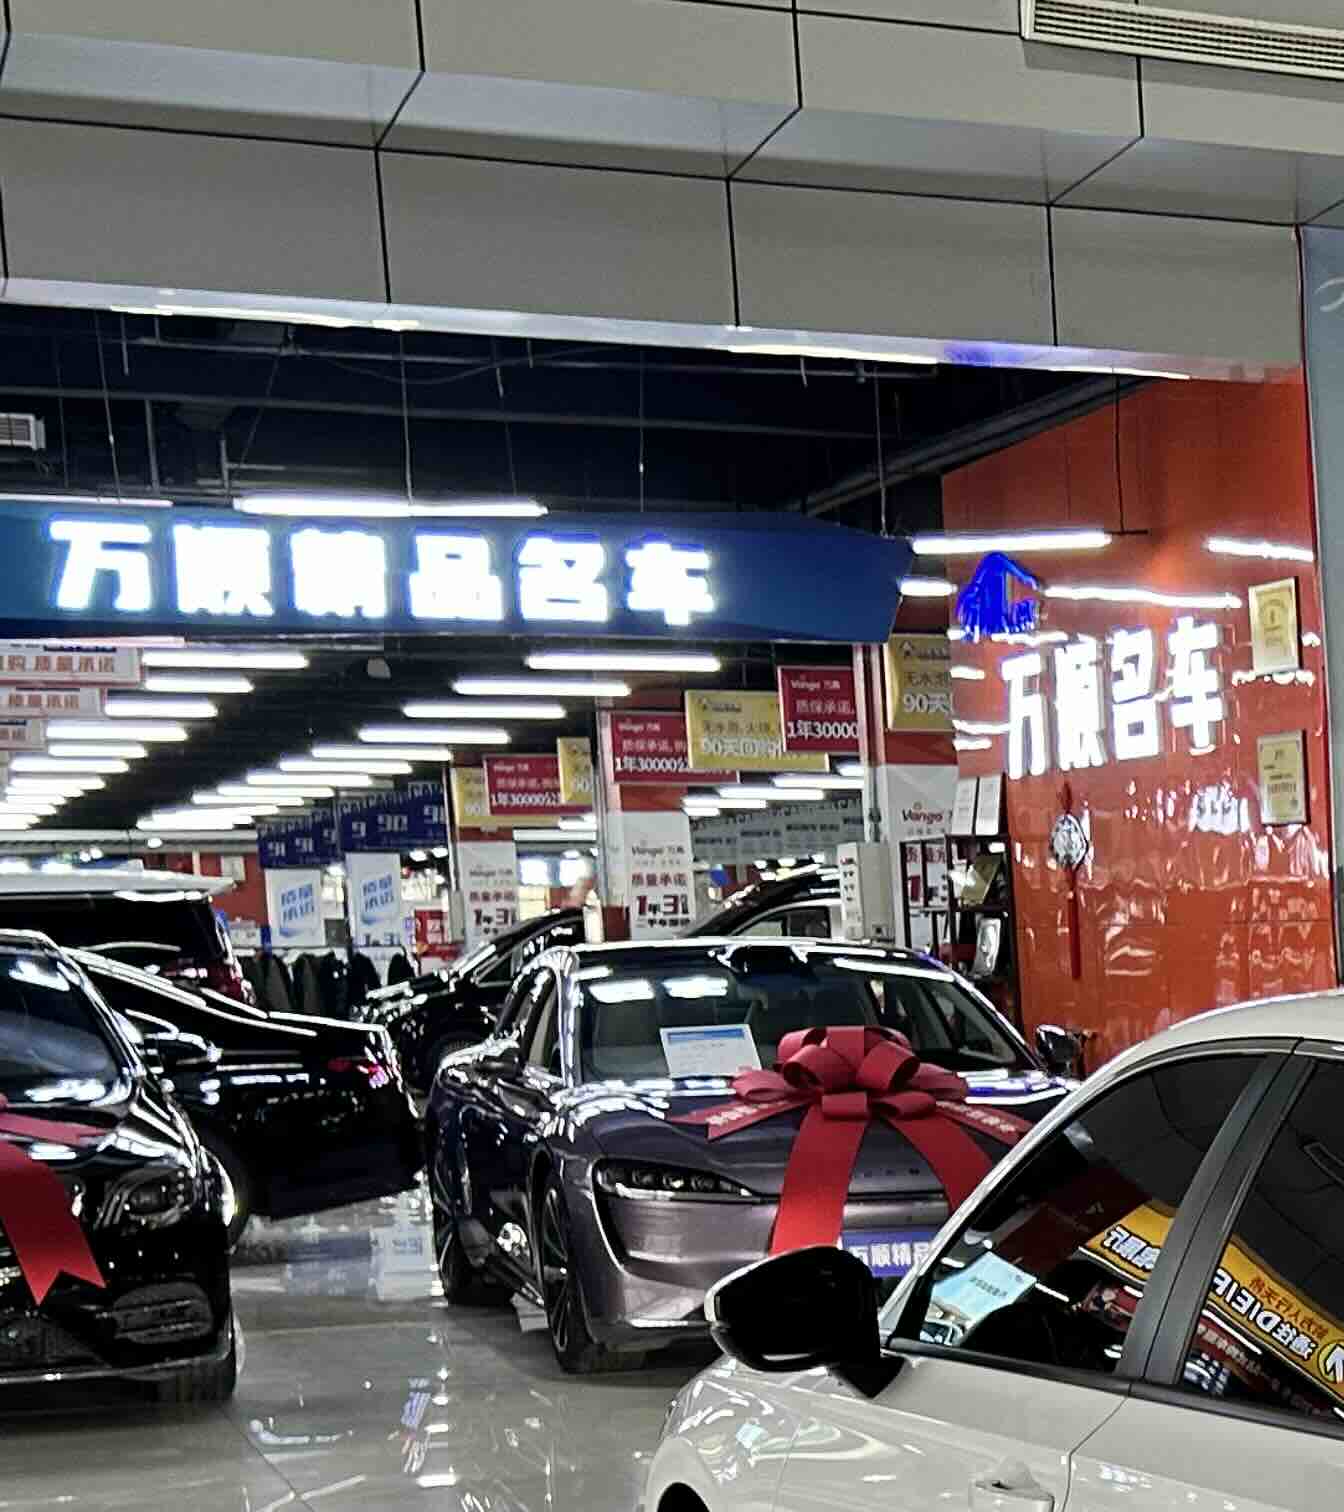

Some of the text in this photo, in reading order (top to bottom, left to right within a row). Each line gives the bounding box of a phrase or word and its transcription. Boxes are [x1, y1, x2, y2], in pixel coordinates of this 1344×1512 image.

[48, 519, 716, 625] 万顺精品名车
[1001, 617, 1224, 780] 万顺名车
